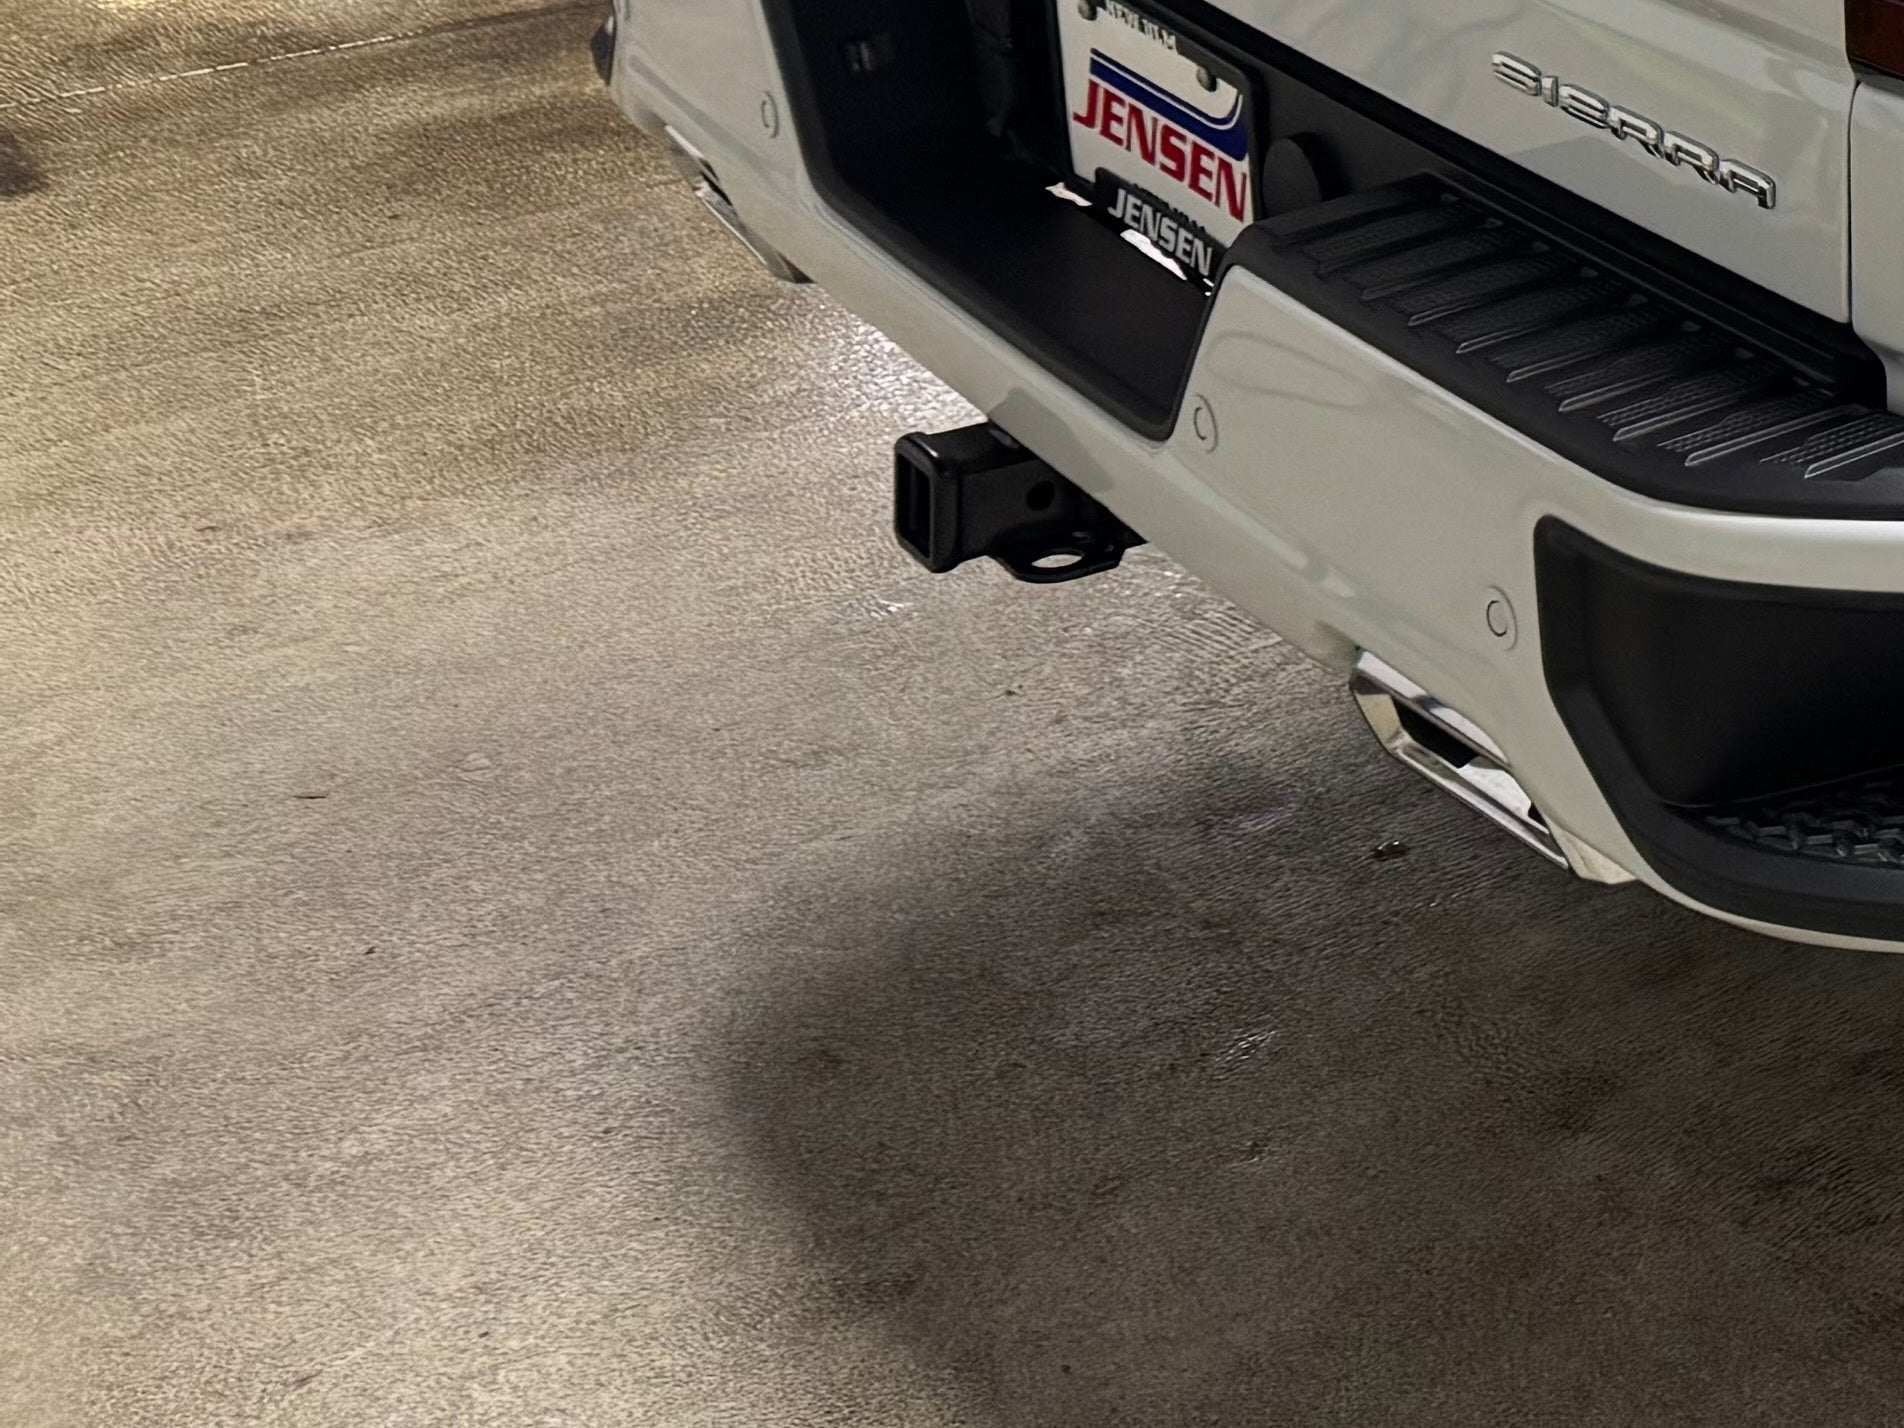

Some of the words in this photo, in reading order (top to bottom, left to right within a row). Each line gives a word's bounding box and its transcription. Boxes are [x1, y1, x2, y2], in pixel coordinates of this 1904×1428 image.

[1072, 78, 1248, 223] JENSEN
[1491, 51, 1777, 210] SIERRA
[1107, 188, 1212, 277] JENSEN
